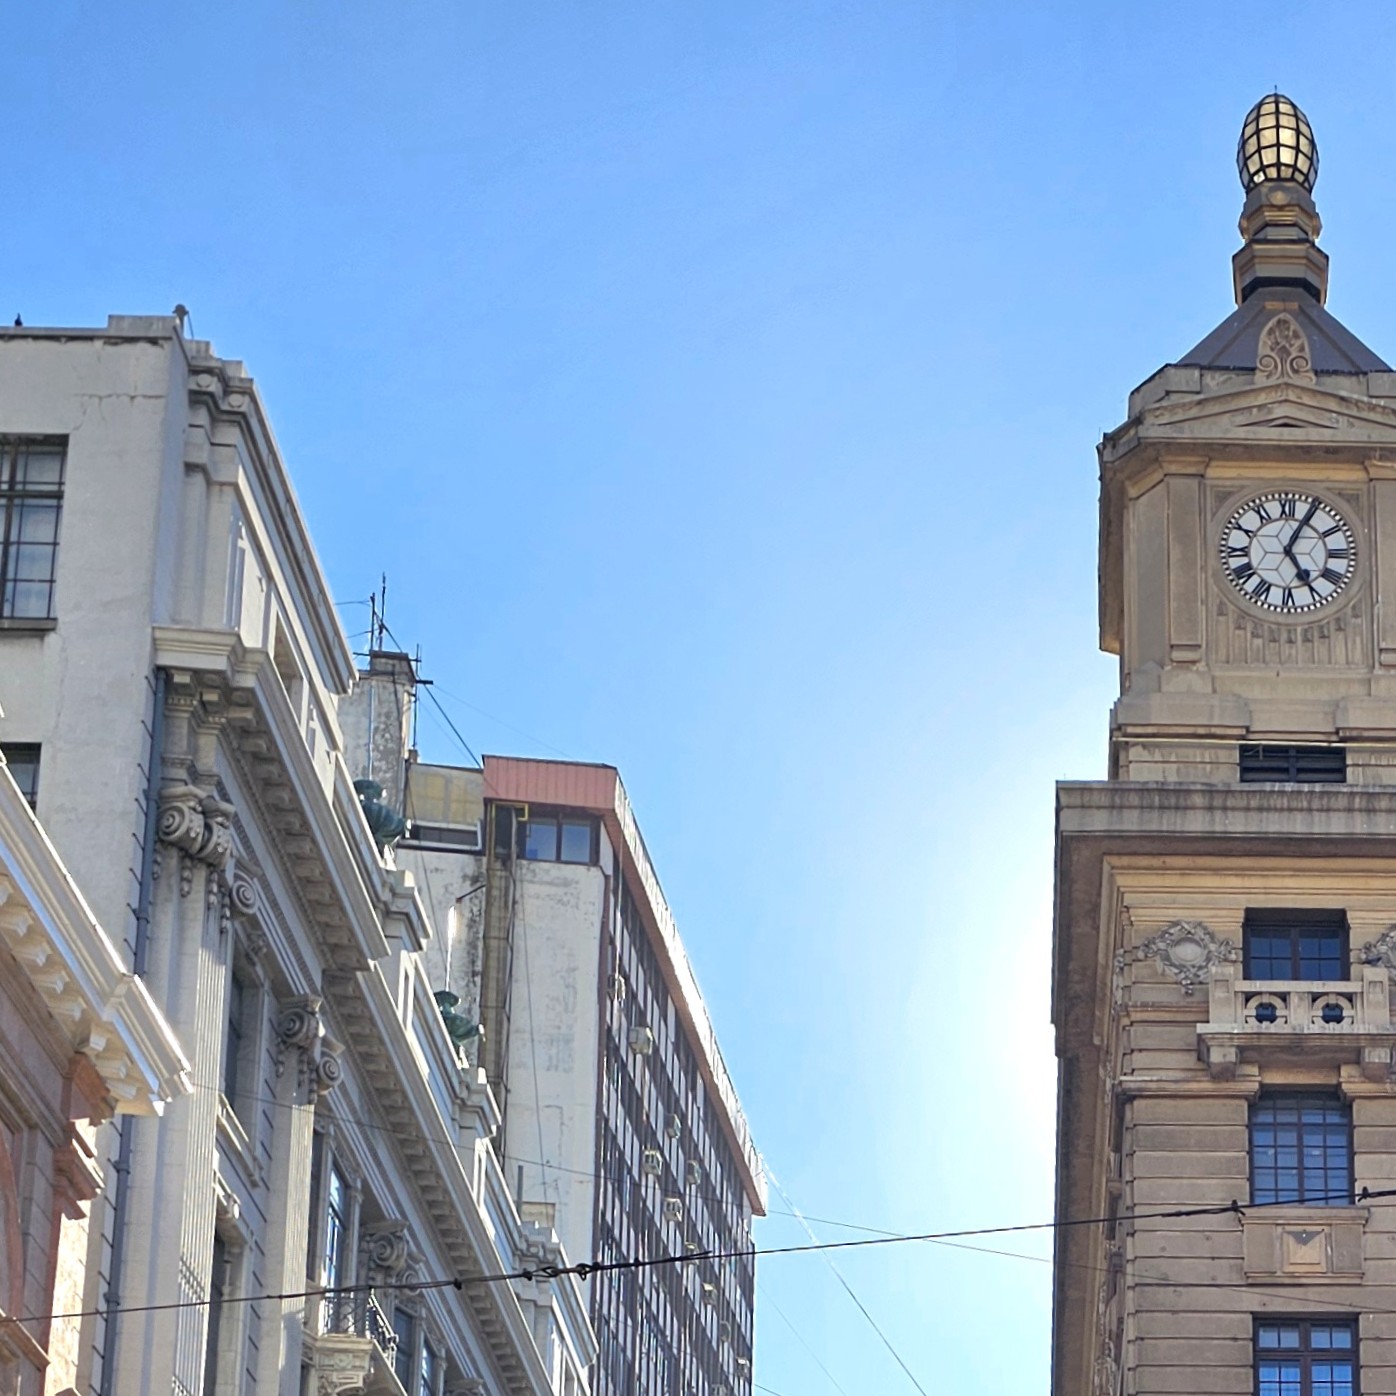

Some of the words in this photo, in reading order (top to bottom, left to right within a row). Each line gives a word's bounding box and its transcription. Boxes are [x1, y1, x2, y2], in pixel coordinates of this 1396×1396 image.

[1279, 499, 1296, 518] XII
[1233, 521, 1254, 538] X
[1322, 525, 1341, 538] II
[1328, 548, 1348, 559] III
